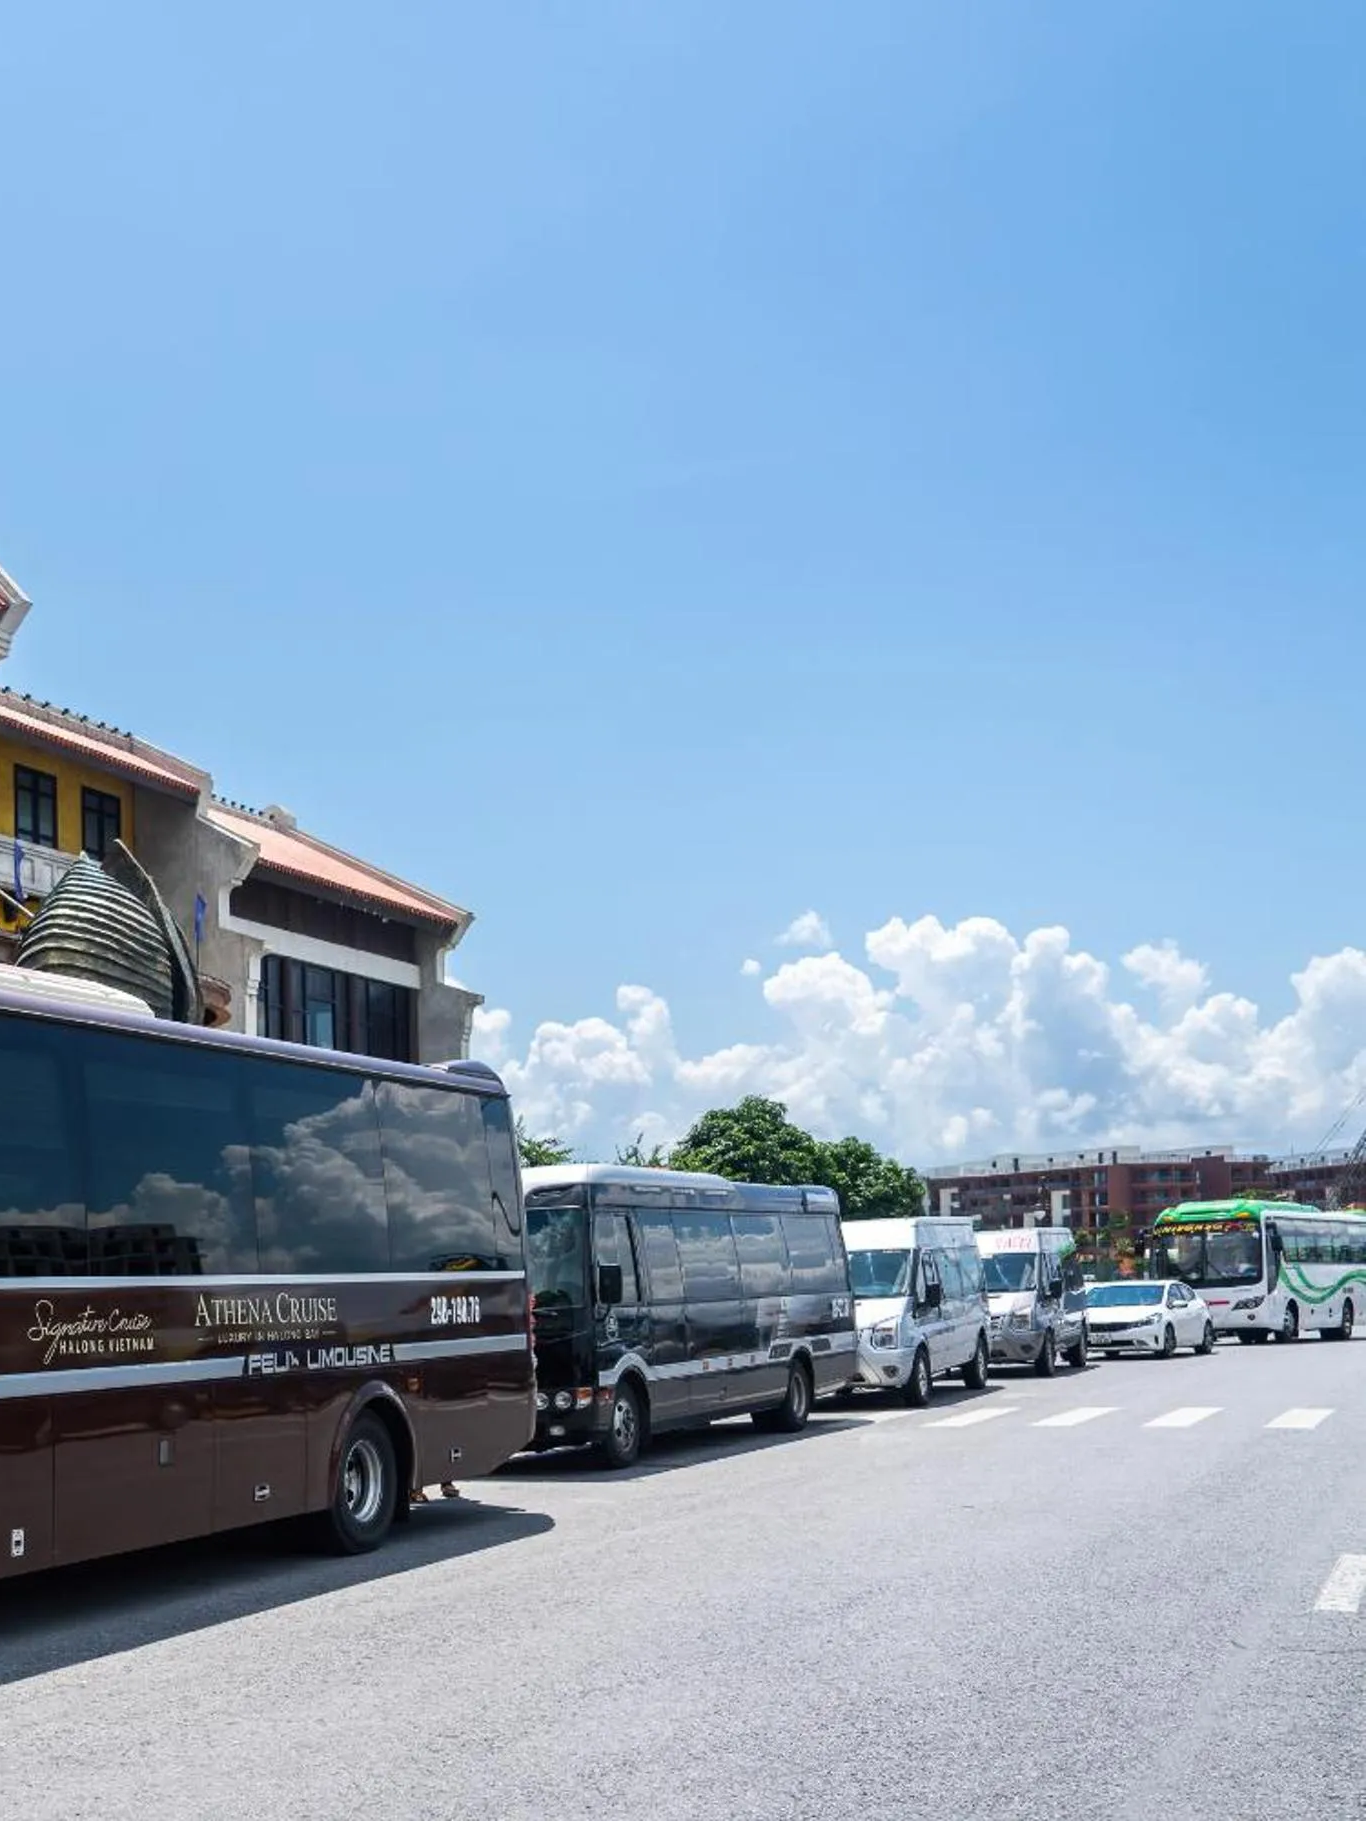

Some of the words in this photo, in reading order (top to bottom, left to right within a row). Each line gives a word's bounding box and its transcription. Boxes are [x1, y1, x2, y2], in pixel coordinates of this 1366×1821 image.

[194, 1293, 273, 1327] ATHENA
[276, 1292, 338, 1323] CRUISE
[27, 1300, 107, 1365] Signature
[59, 1339, 104, 1355] HALONG
[109, 1337, 155, 1353] VIETNAM
